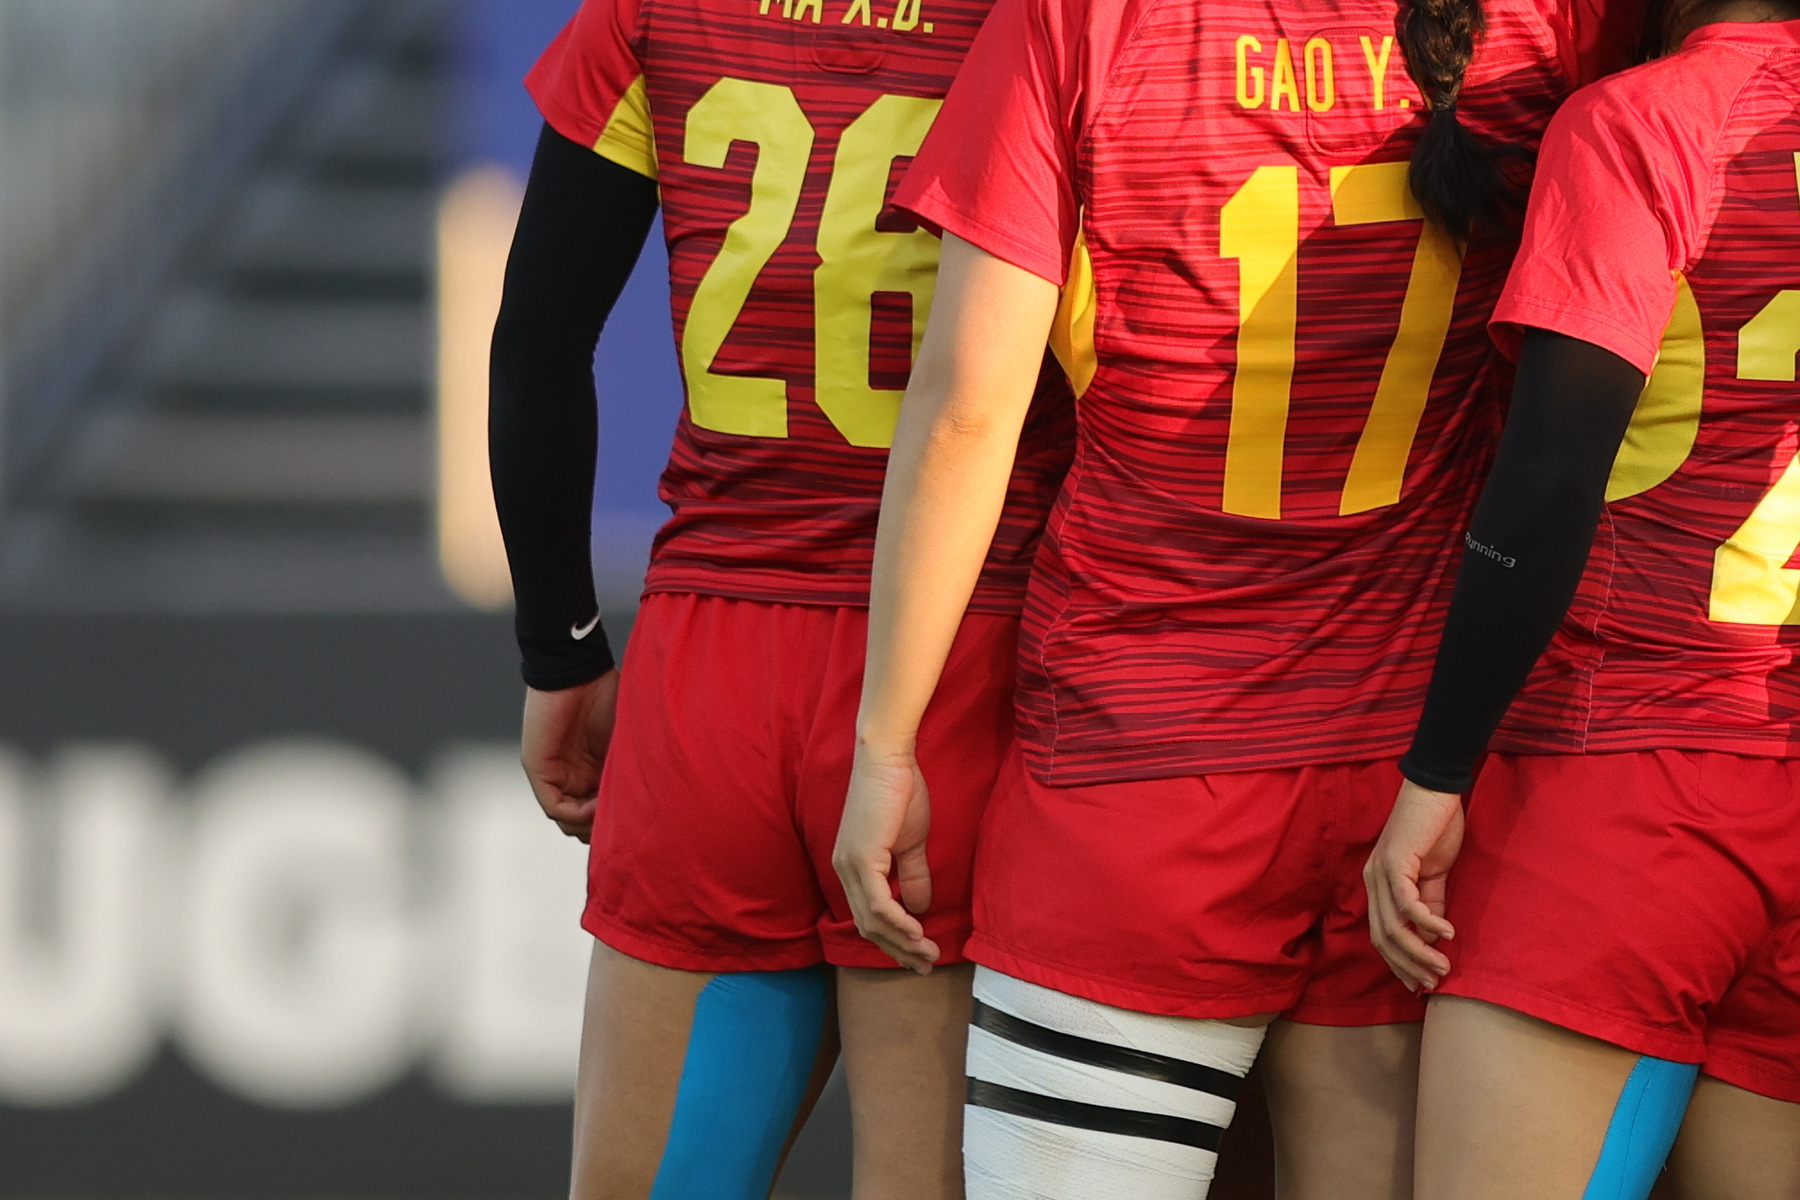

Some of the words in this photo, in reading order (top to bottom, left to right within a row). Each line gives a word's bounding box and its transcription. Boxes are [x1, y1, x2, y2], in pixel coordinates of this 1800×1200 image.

[1235, 36, 1336, 112] GAO
[1360, 36, 1410, 111] Y.
[683, 76, 944, 449] 26
[1219, 160, 1467, 521] 17
